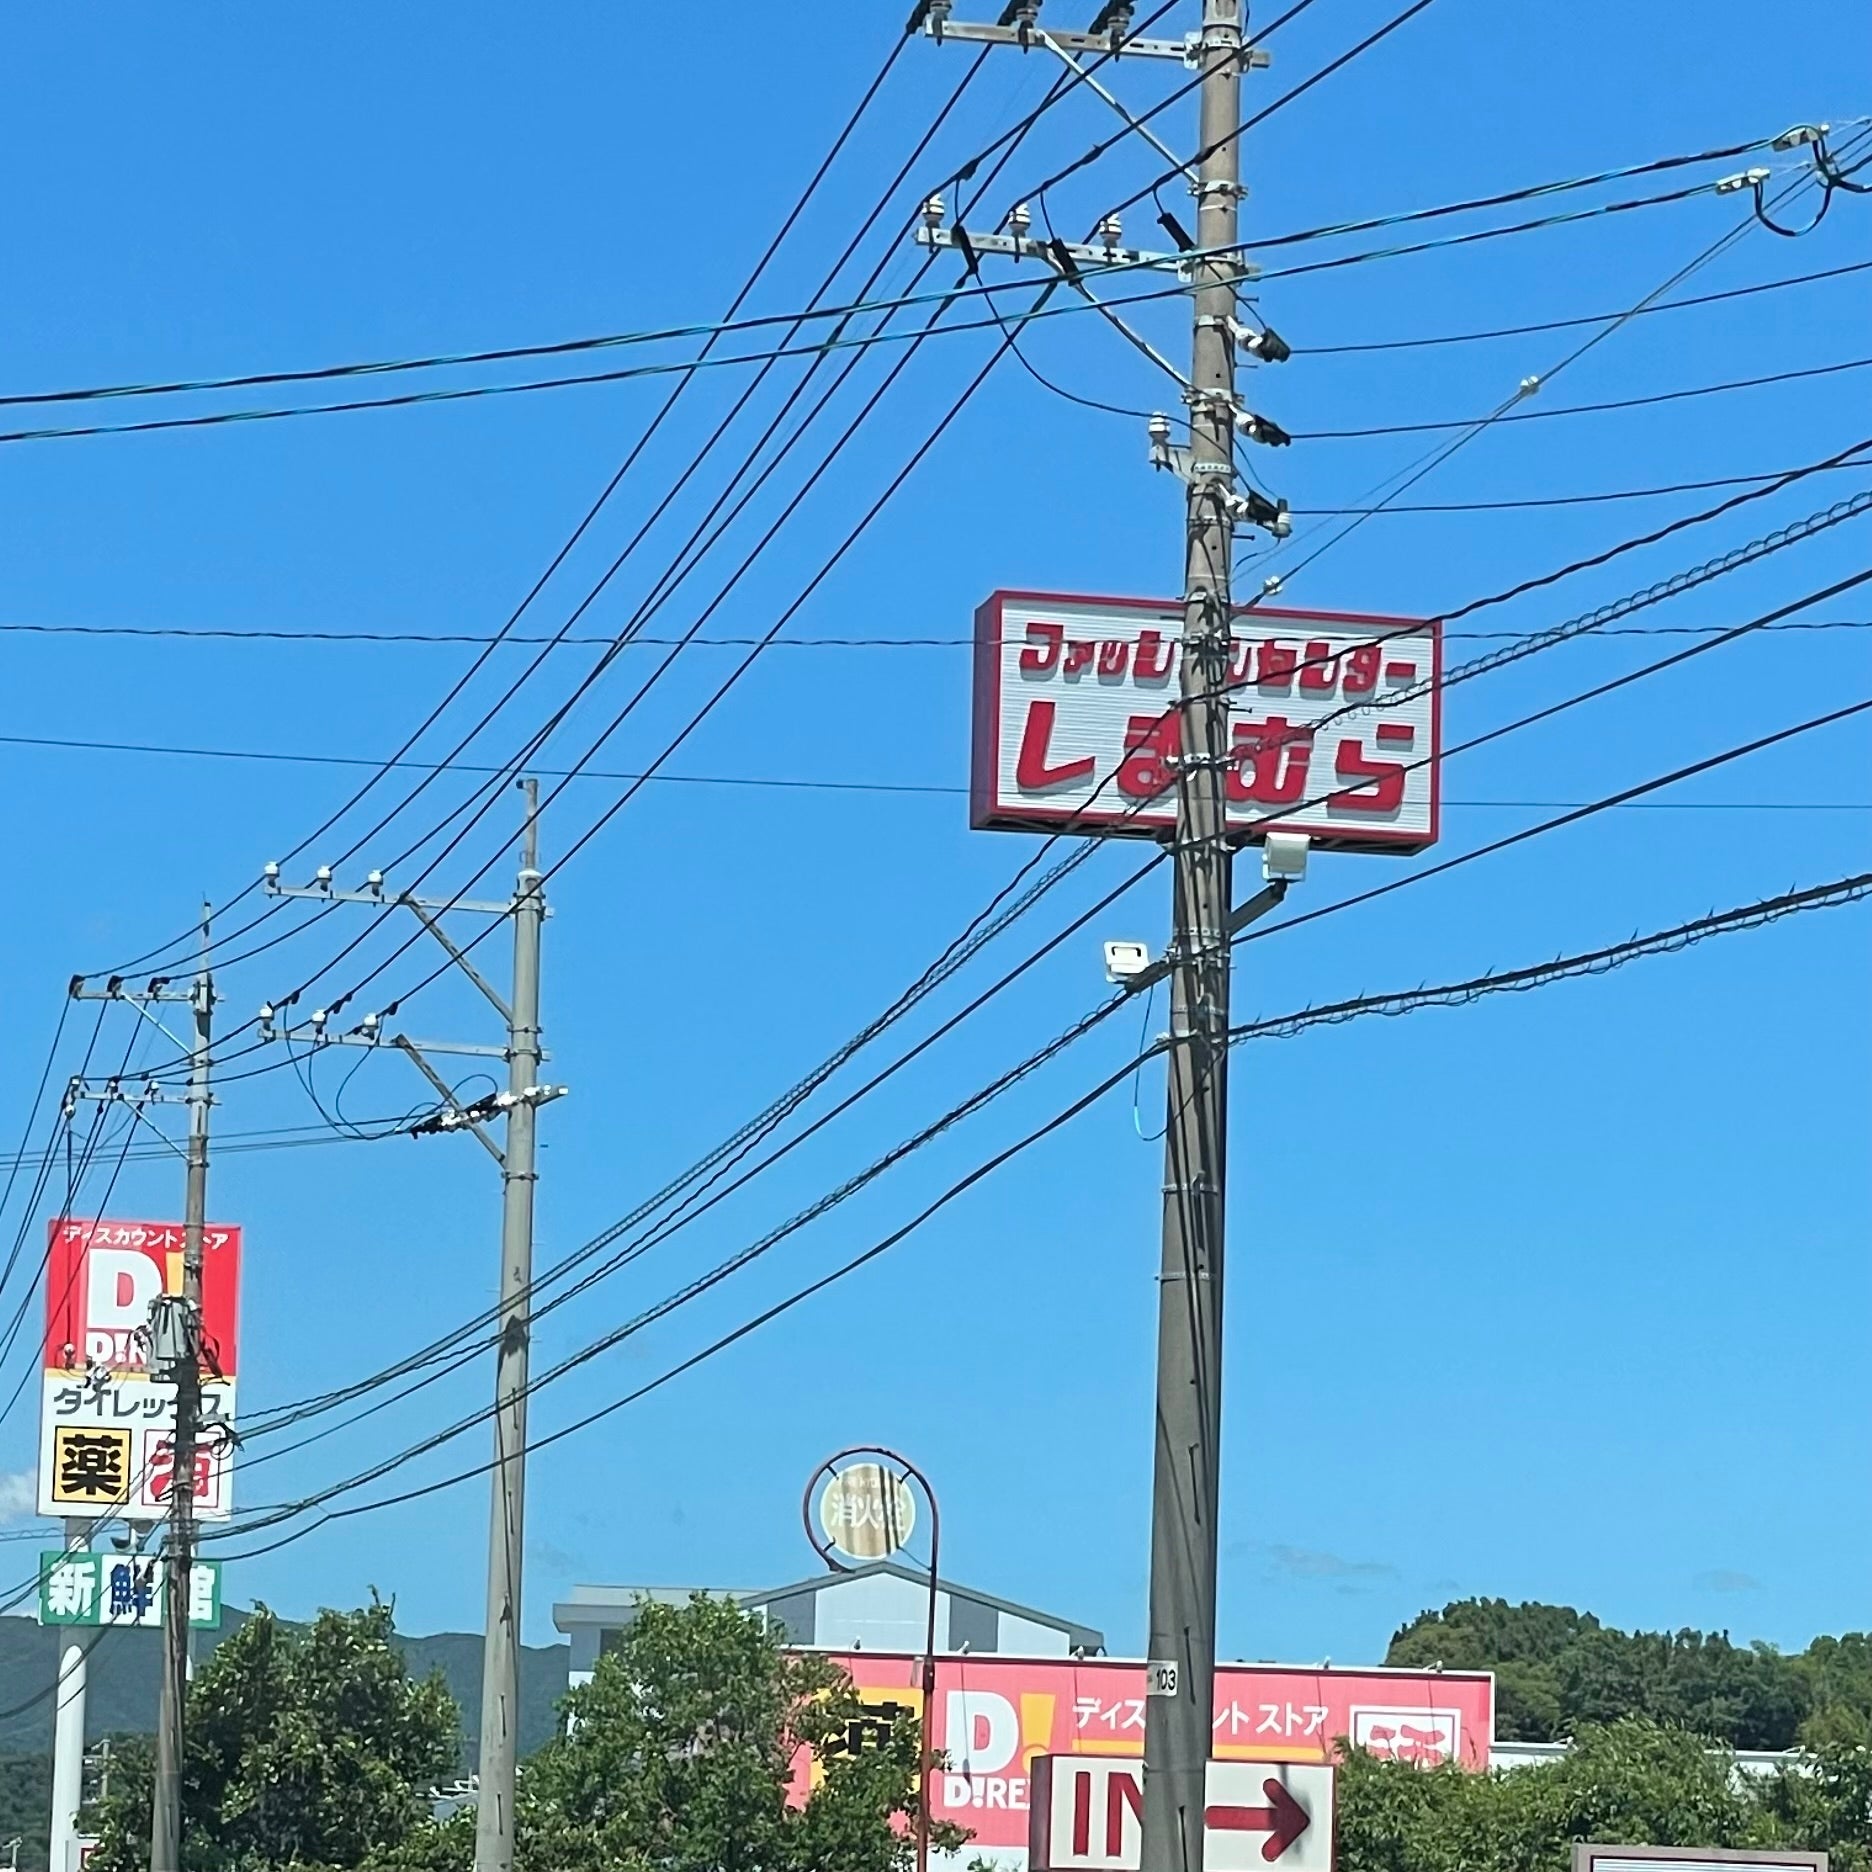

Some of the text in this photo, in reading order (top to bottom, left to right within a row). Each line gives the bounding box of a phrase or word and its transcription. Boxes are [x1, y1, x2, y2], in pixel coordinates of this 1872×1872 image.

[1019, 622, 1416, 697] ファッシンセンター
[1016, 701, 1415, 812] しまむら
[63, 1226, 229, 1250] ディスカウントア
[54, 1387, 221, 1419] ダイレッス
[62, 1434, 122, 1496] 薬
[1072, 1697, 1249, 1736] ディスント
[943, 1777, 1030, 1810] D!RE
